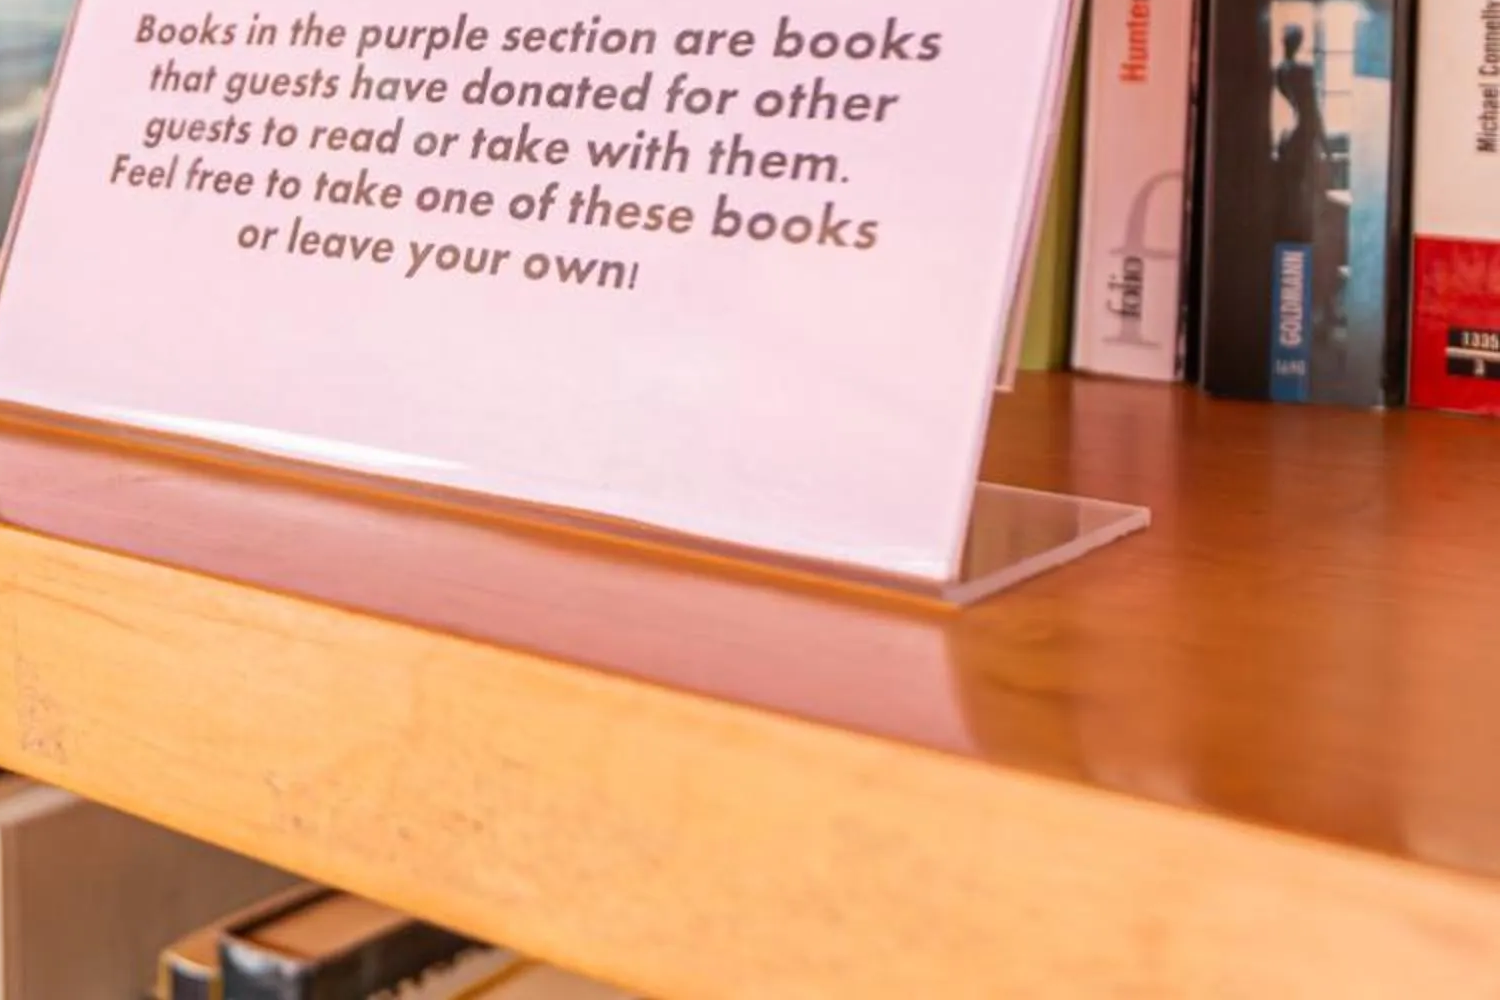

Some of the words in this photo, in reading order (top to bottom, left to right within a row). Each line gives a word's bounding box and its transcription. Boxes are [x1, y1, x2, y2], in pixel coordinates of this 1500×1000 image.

[135, 11, 237, 46] Books
[245, 12, 278, 47] in
[289, 11, 347, 49] the
[355, 12, 489, 61] purple
[500, 14, 657, 55] section
[673, 28, 756, 58] are
[772, 14, 943, 62] books
[149, 58, 218, 94] that
[222, 68, 341, 105] guests
[349, 62, 449, 104] have
[461, 65, 654, 112] donated
[664, 71, 740, 116] for
[753, 75, 901, 123] other
[1476, 83, 1500, 154] Michael
[142, 114, 252, 149] guests
[261, 116, 299, 148] to
[308, 116, 405, 155] read
[413, 131, 461, 158] or
[469, 121, 570, 166] take
[587, 129, 690, 174] with
[707, 132, 850, 184] them.
[109, 153, 179, 190] Feel
[185, 156, 255, 197] free
[265, 168, 302, 201] to
[313, 167, 403, 210] take
[415, 185, 495, 218] one
[508, 181, 560, 222] of
[567, 183, 695, 235] these
[710, 192, 880, 250] books
[237, 224, 280, 251] or
[286, 215, 395, 264] leave
[404, 241, 511, 279] your
[523, 252, 640, 291] own!
[1107, 255, 1143, 321] folio
[1279, 249, 1307, 349] GOLDMANN
